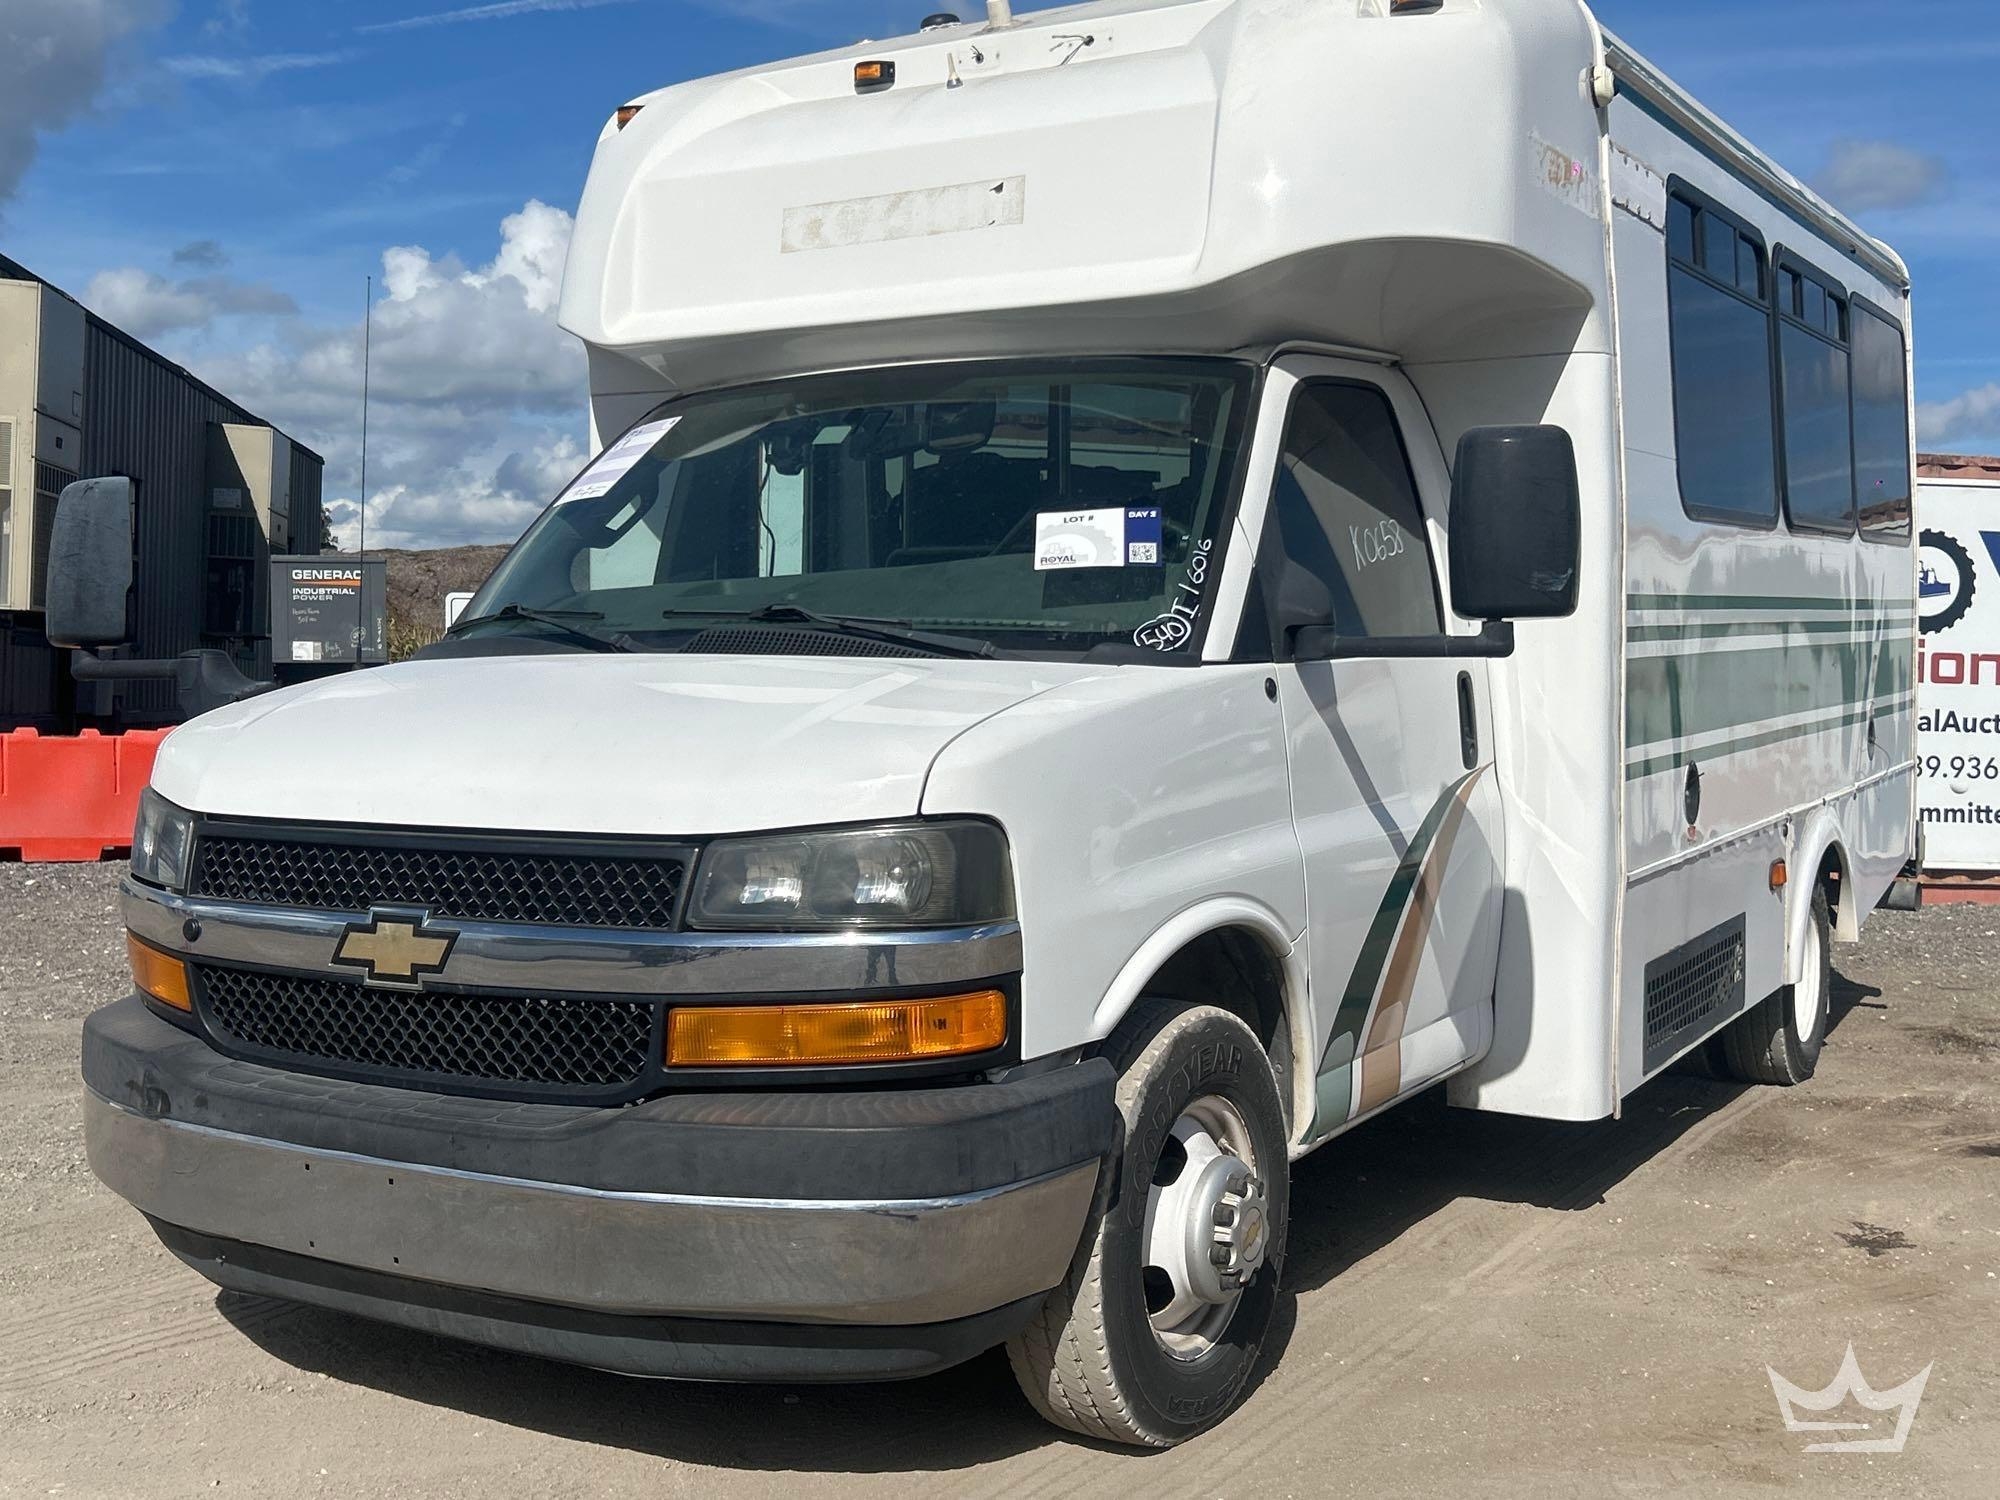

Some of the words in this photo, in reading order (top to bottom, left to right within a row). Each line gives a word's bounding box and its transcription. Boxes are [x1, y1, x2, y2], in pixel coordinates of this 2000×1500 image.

[1063, 515, 1084, 524] LOT
[1040, 555, 1077, 564] ROYAL
[292, 569, 361, 580] GENERAC
[292, 587, 355, 595] INDUSTRIAL
[1140, 620, 1185, 651] 540
